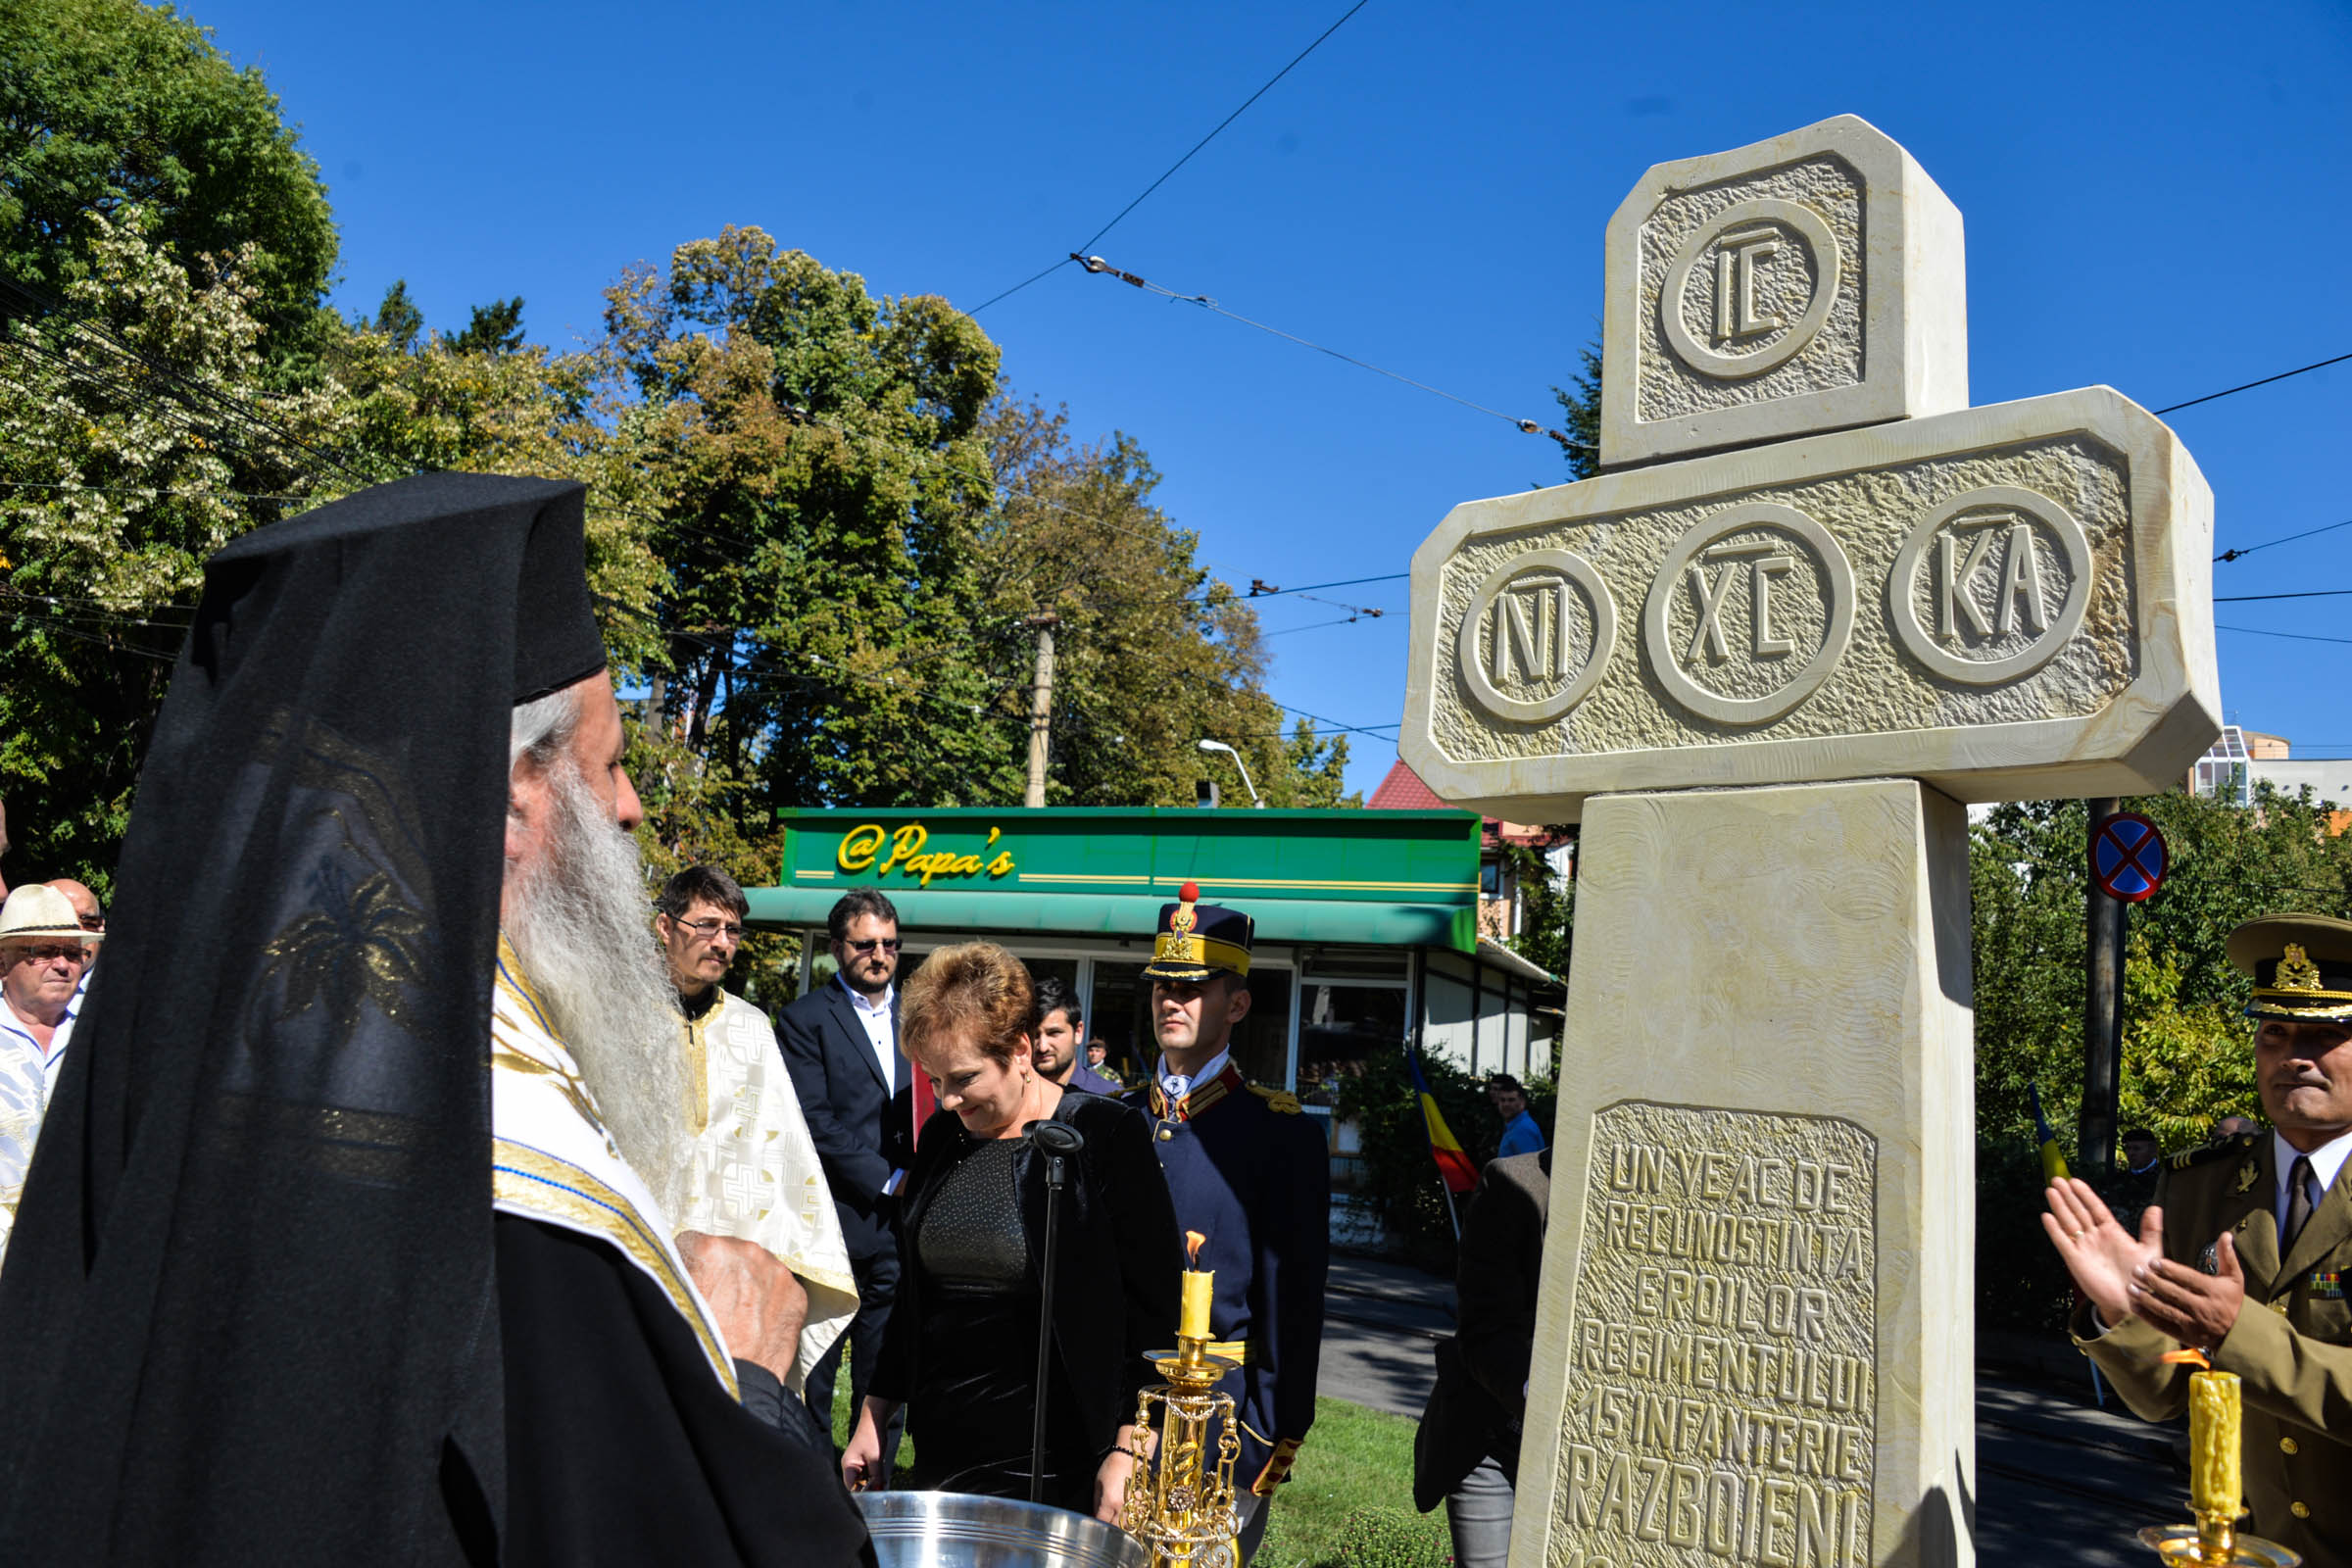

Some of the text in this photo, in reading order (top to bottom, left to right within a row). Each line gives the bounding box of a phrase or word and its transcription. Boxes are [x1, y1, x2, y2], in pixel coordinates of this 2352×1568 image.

[1937, 512, 2049, 639] KA
[1611, 1143, 1852, 1215] UN VEAC DE
[1604, 1200, 1864, 1281] RECUNOSTINTA
[1635, 1265, 1830, 1343] EROILOR
[1579, 1317, 1870, 1414] REGIMENTULUI
[1576, 1382, 1864, 1482] 15 INFANTERIE
[1567, 1443, 1859, 1568] RAZBOIENI
